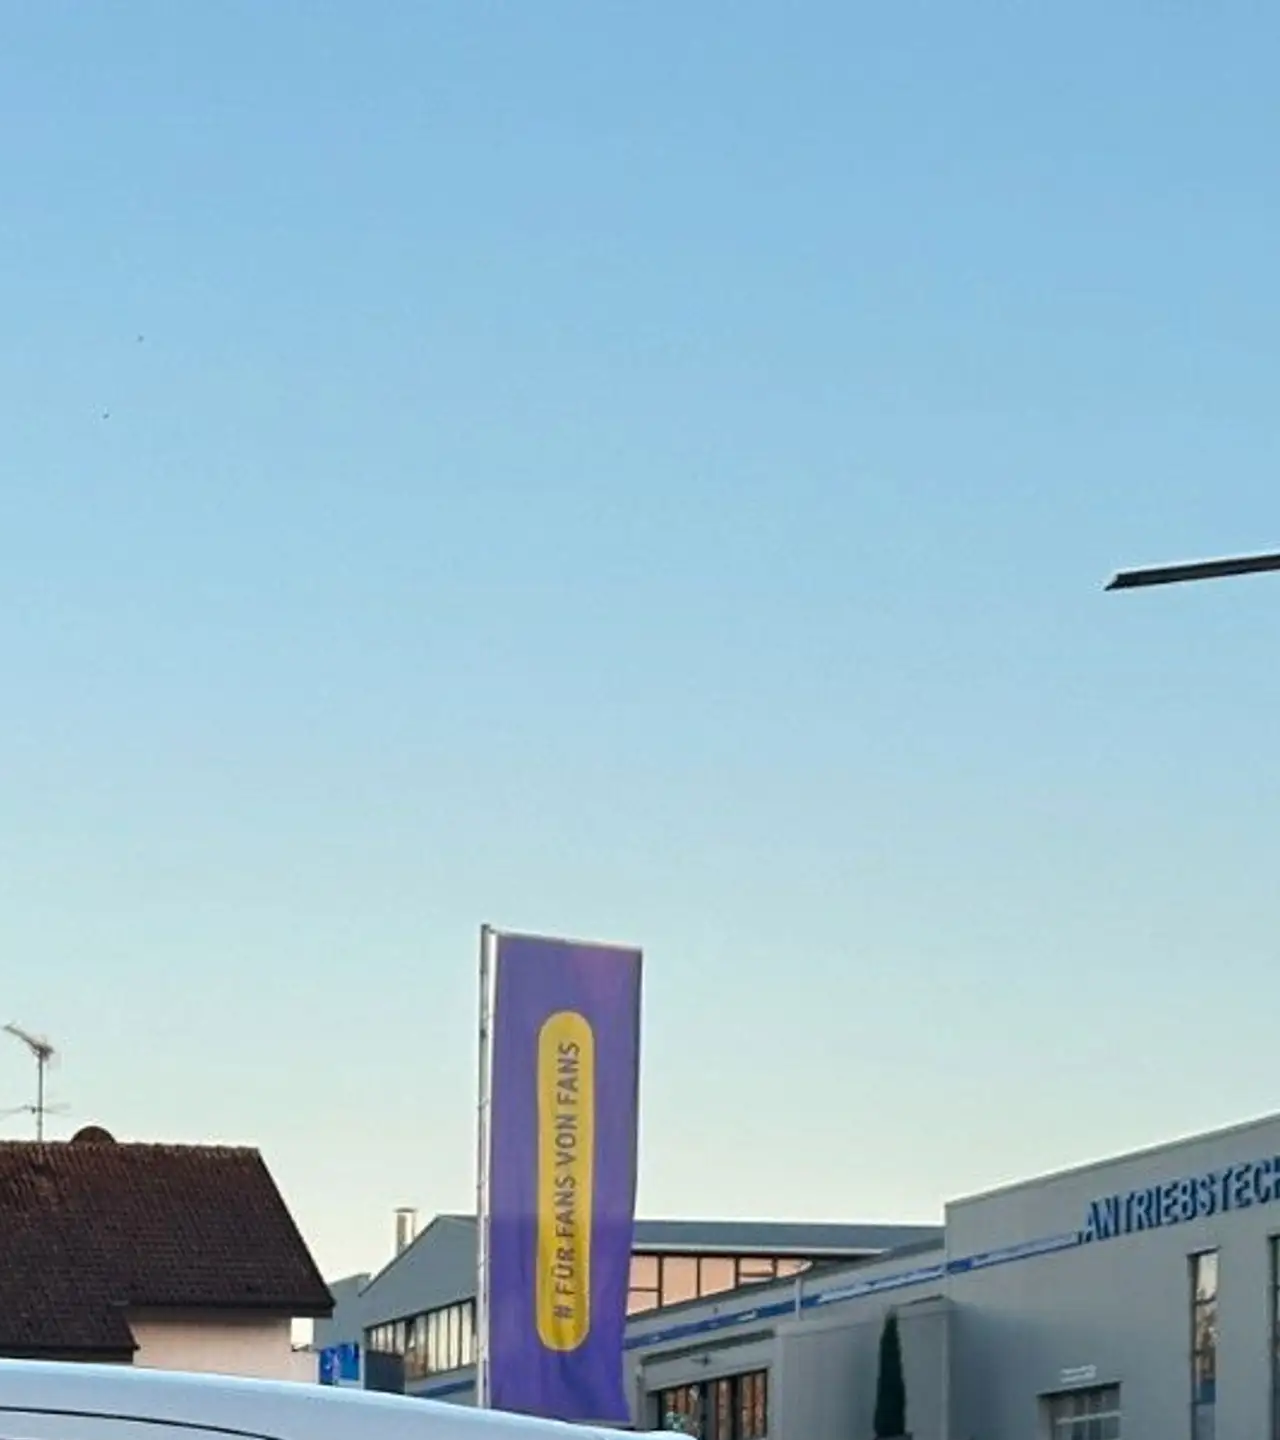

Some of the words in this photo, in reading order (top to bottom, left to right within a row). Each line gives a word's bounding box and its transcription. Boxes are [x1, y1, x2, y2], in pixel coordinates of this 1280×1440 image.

[556, 1041, 581, 1106] FANS
[554, 1113, 579, 1168] VON
[554, 1175, 577, 1240] FANS
[551, 1246, 575, 1297] FÜR
